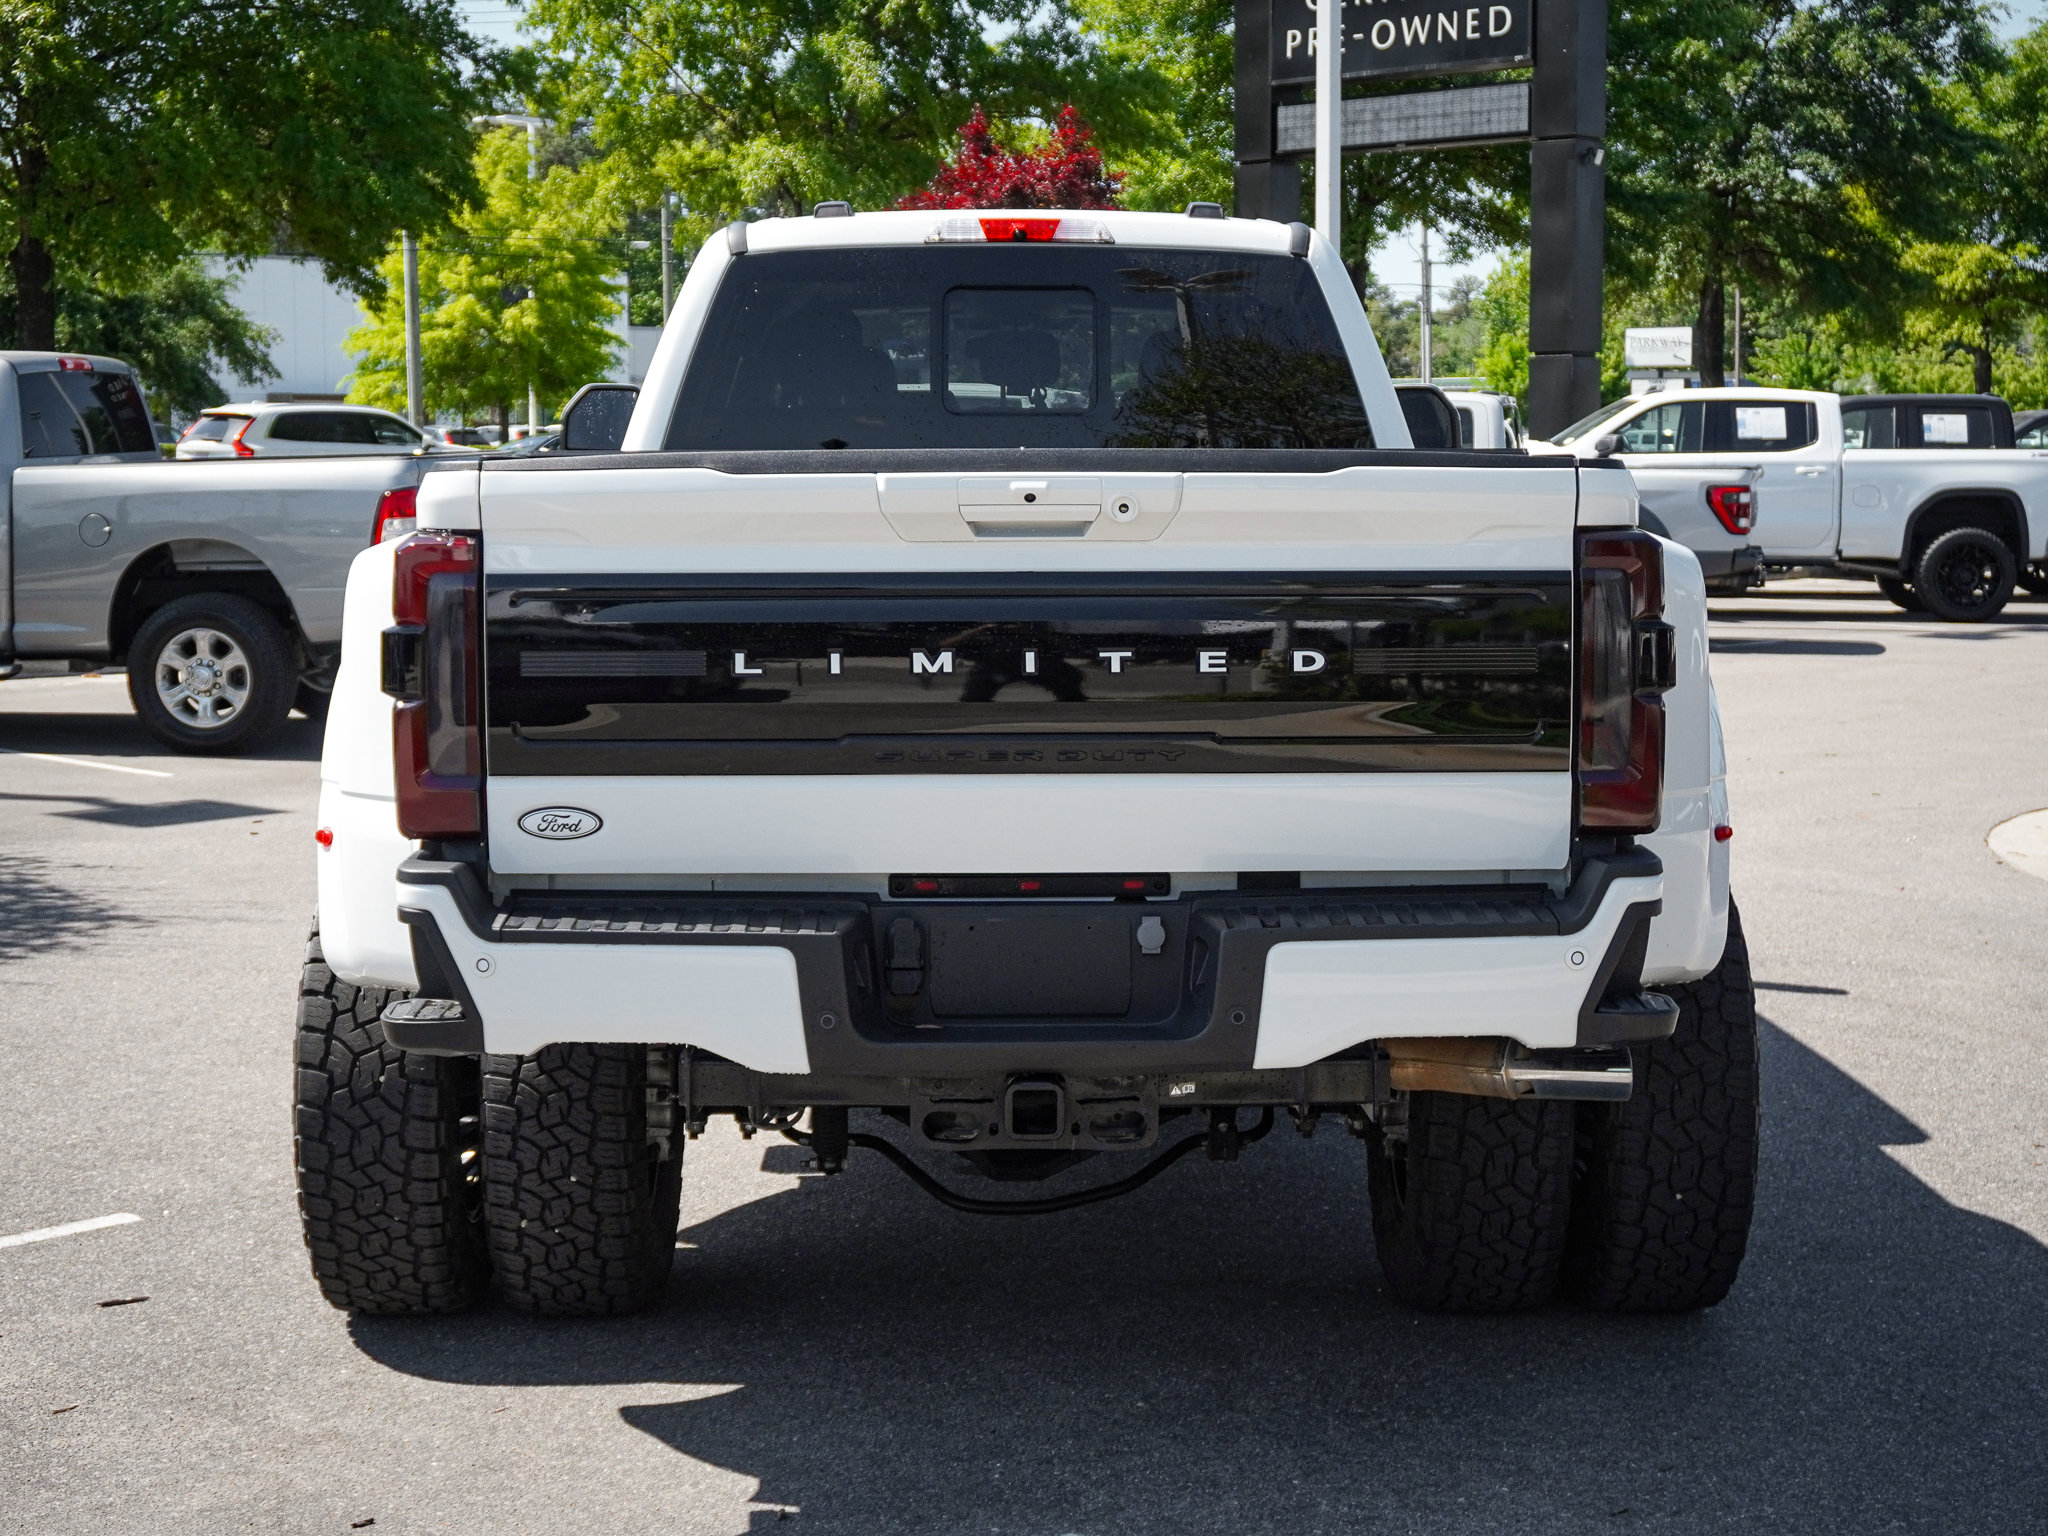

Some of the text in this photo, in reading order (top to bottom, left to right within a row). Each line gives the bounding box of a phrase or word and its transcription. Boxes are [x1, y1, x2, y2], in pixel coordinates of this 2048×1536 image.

[732, 649, 1327, 675] LIMITED
[873, 750, 1186, 762] SUPER DUTY
[537, 813, 582, 833] Ford
